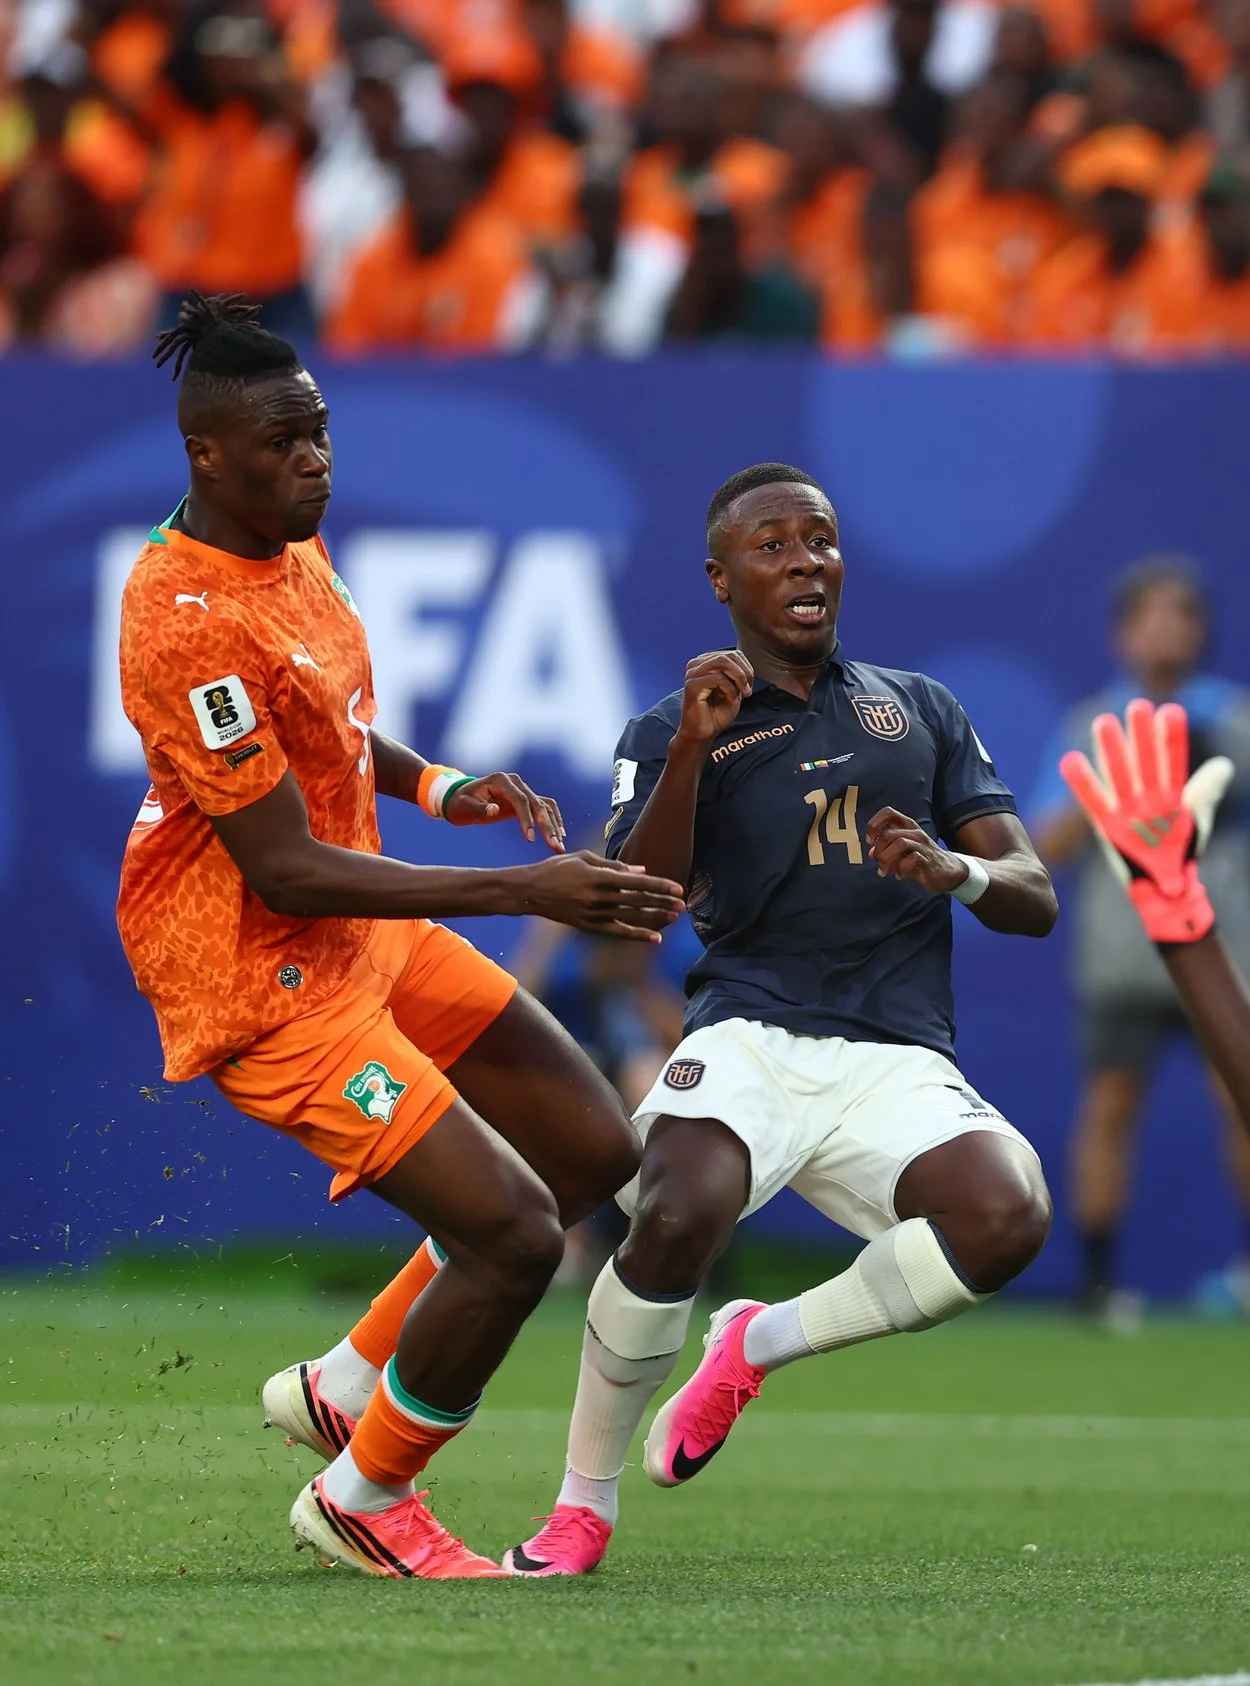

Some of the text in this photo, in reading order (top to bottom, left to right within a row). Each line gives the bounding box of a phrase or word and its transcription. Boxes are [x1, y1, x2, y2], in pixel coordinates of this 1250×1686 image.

[219, 726, 244, 741] 2026
[220, 716, 233, 725] FIFA
[711, 723, 795, 763] marathon
[804, 785, 863, 866] 14
